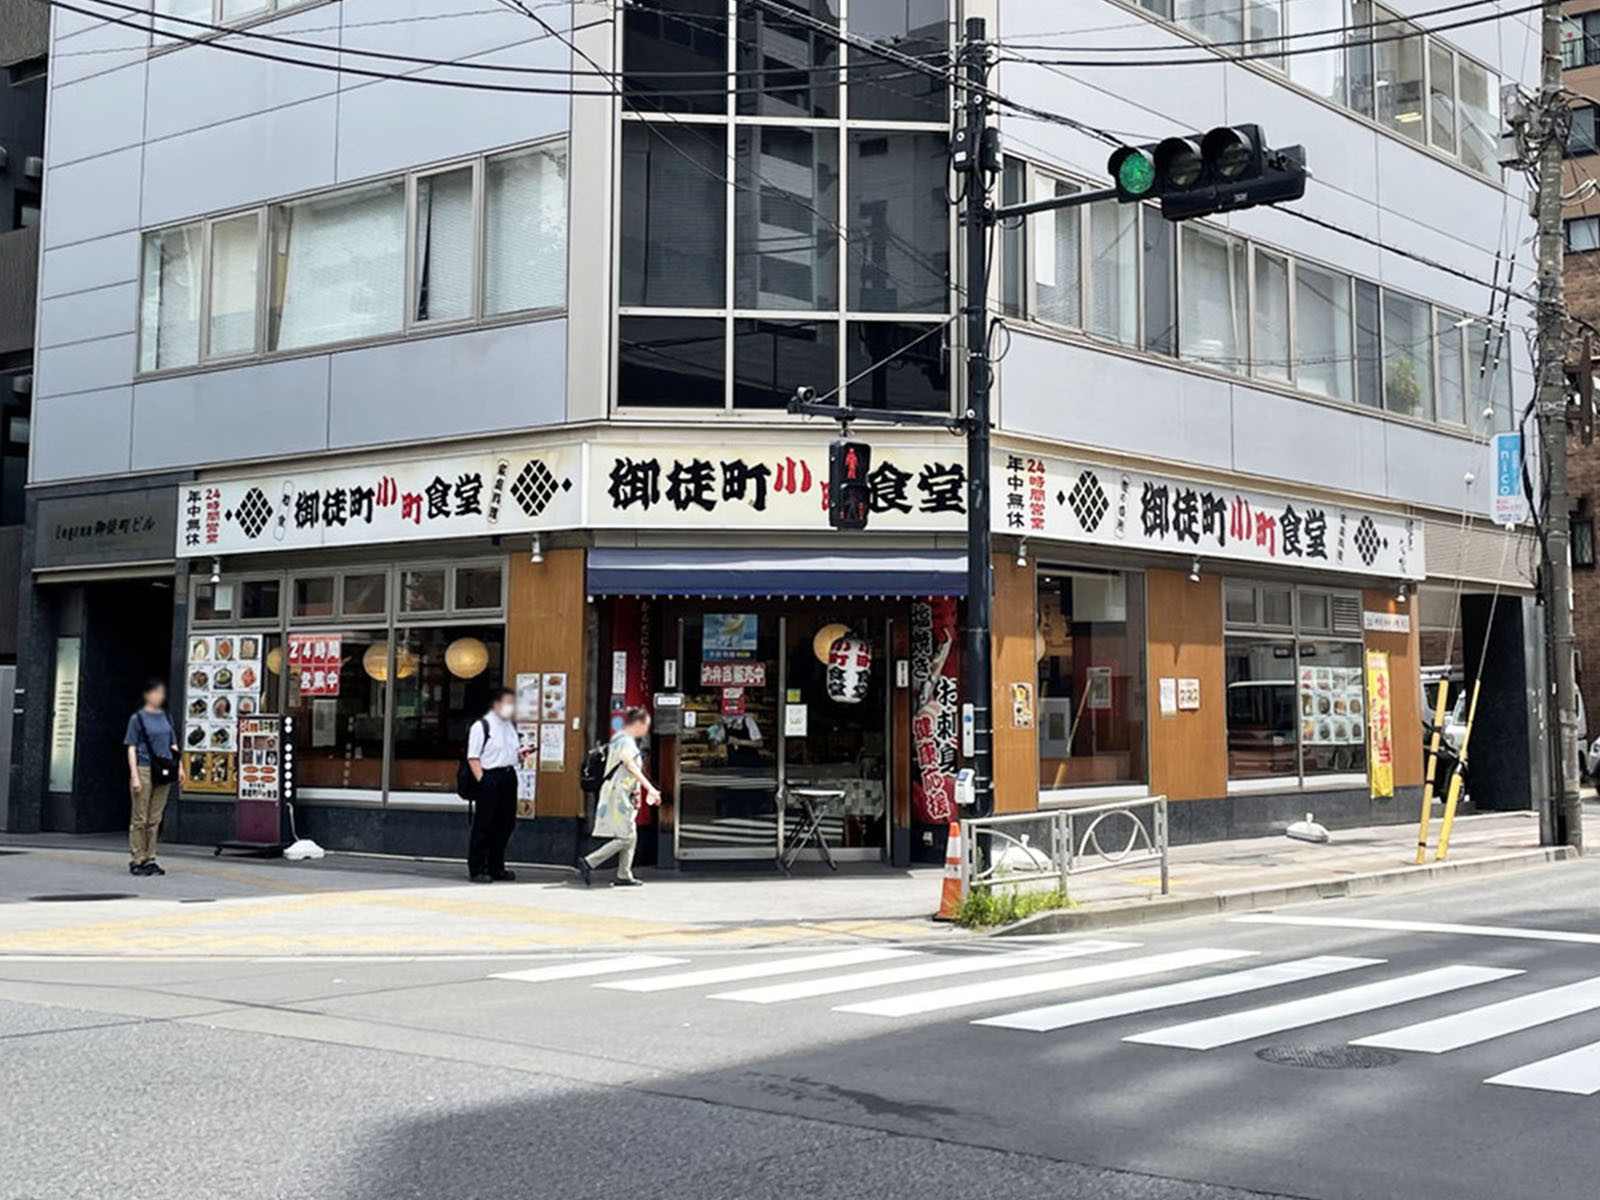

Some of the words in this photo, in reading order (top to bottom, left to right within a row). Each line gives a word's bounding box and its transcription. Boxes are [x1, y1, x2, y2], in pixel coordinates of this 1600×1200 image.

[295, 472, 483, 528] 御徒町小町食堂
[608, 456, 967, 515] 御徒町小食堂
[1006, 455, 1025, 528] 年中無休
[1027, 458, 1046, 530] 24時間営業
[1500, 450, 1510, 494] nico
[186, 490, 201, 546] 年中無休
[205, 488, 221, 544] 24時間営業
[1140, 481, 1328, 561] 御徒町小町食堂
[937, 675, 958, 774] お刺身
